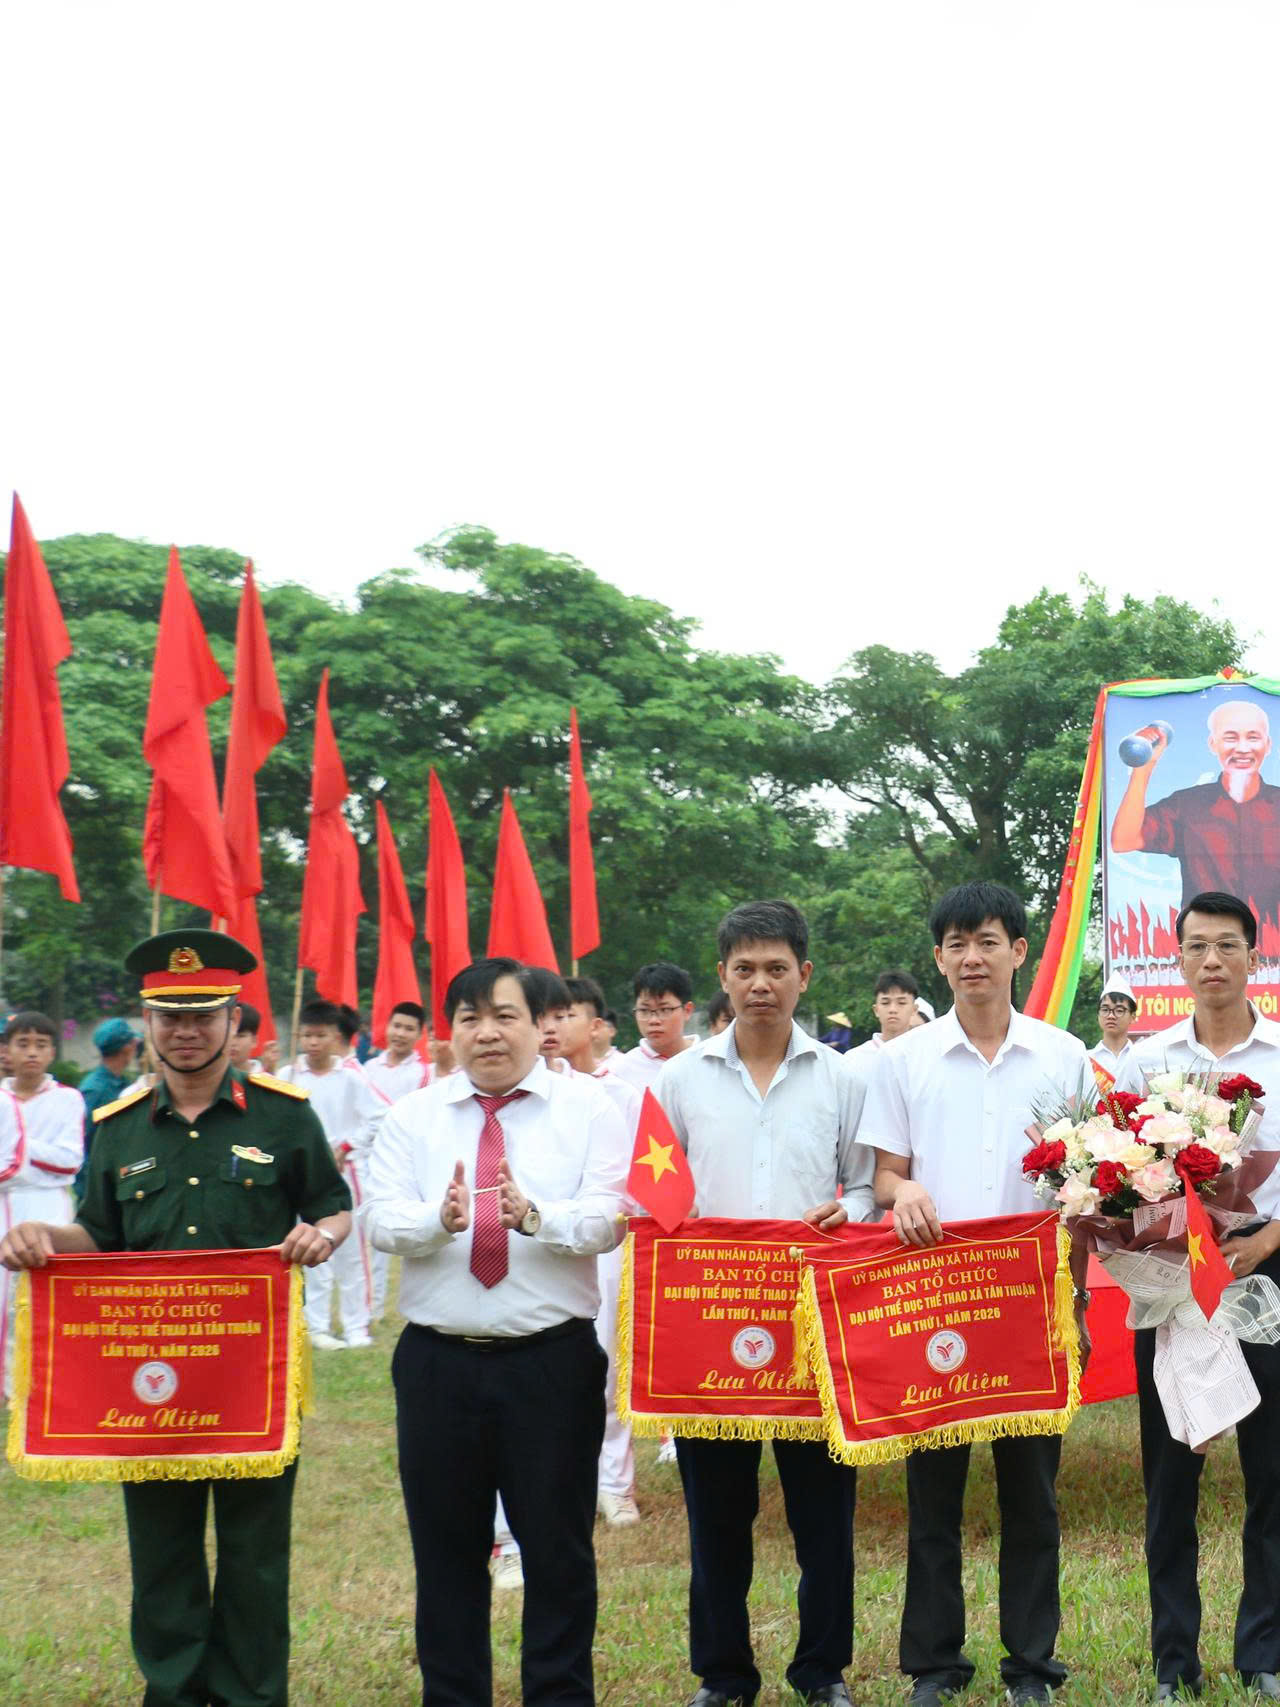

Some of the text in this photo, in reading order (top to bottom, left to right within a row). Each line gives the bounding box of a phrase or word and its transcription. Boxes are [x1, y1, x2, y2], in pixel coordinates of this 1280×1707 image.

[1146, 994, 1170, 1016] TÔI
[1254, 992, 1277, 1014] TÔI
[693, 1249, 714, 1260] BAN
[717, 1248, 746, 1261] NHÂN
[750, 1249, 770, 1261] DÂN
[773, 1249, 787, 1262] XÃ
[869, 1269, 891, 1282] BAN
[893, 1260, 921, 1276] NHÂN
[924, 1255, 945, 1270] DÂN
[947, 1253, 961, 1266] XÃ
[963, 1250, 983, 1263] TÂN
[986, 1247, 1019, 1262] THUẬN
[703, 1268, 739, 1281] BAN
[743, 1264, 766, 1282] TỔ
[882, 1267, 998, 1299] BAN TỔ CHỨC
[100, 1299, 222, 1318] BAN TỔ CHỨC
[703, 1305, 725, 1320] LẦN
[727, 1308, 749, 1320] THỨ
[751, 1309, 758, 1321] I,
[761, 1307, 787, 1320] NĂM
[850, 1283, 1036, 1327] ĐẠI HỘI THỂ DỤC THỂ THAO XÃ TÂN THUẬN
[889, 1307, 1000, 1337] LẦN THỨ I, NĂM 2026
[698, 1370, 745, 1389] Lưu
[901, 1372, 1011, 1406] Lưu Niệm
[98, 1408, 221, 1431] Lưu Niệm
